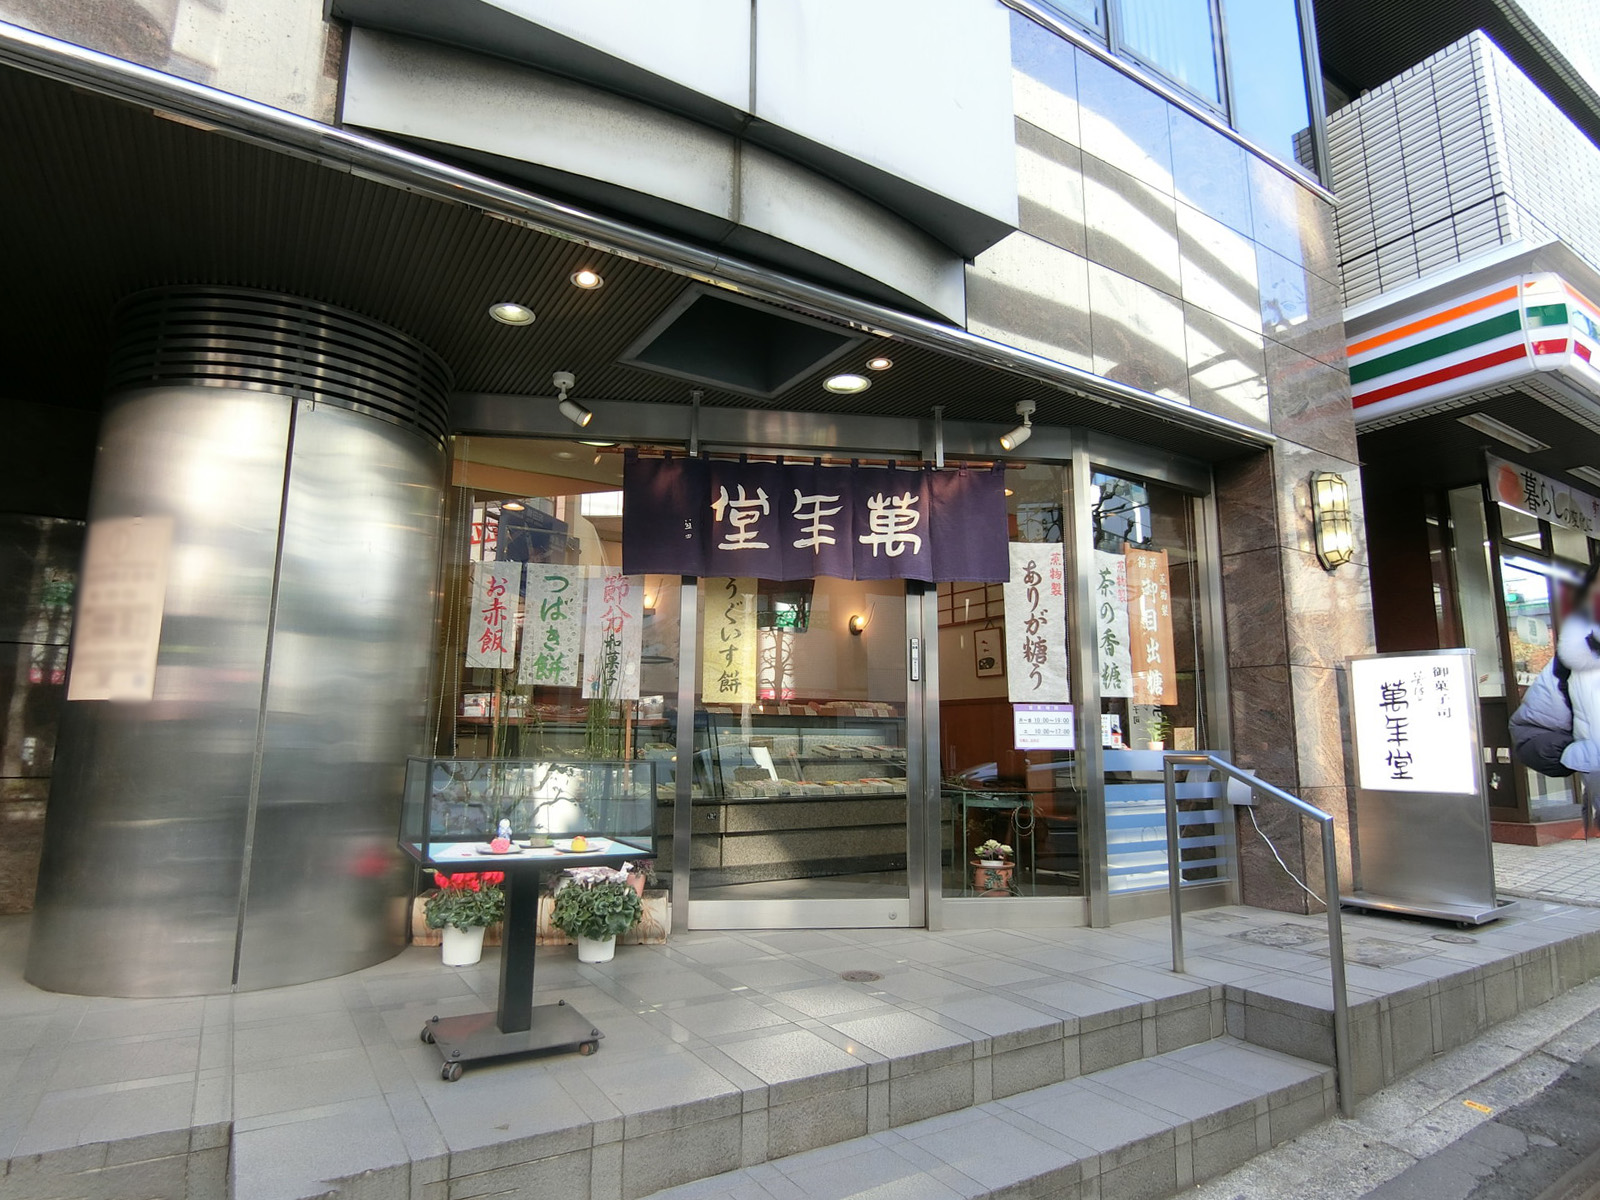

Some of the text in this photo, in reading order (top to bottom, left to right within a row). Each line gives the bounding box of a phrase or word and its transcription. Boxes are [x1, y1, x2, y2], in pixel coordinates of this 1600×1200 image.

[478, 575, 508, 654] お赤飯
[533, 575, 574, 684] つばき餅
[1022, 559, 1049, 691] ありが糖う
[1097, 567, 1122, 690] 茶の香糖
[1379, 679, 1414, 780] 萬年堂
